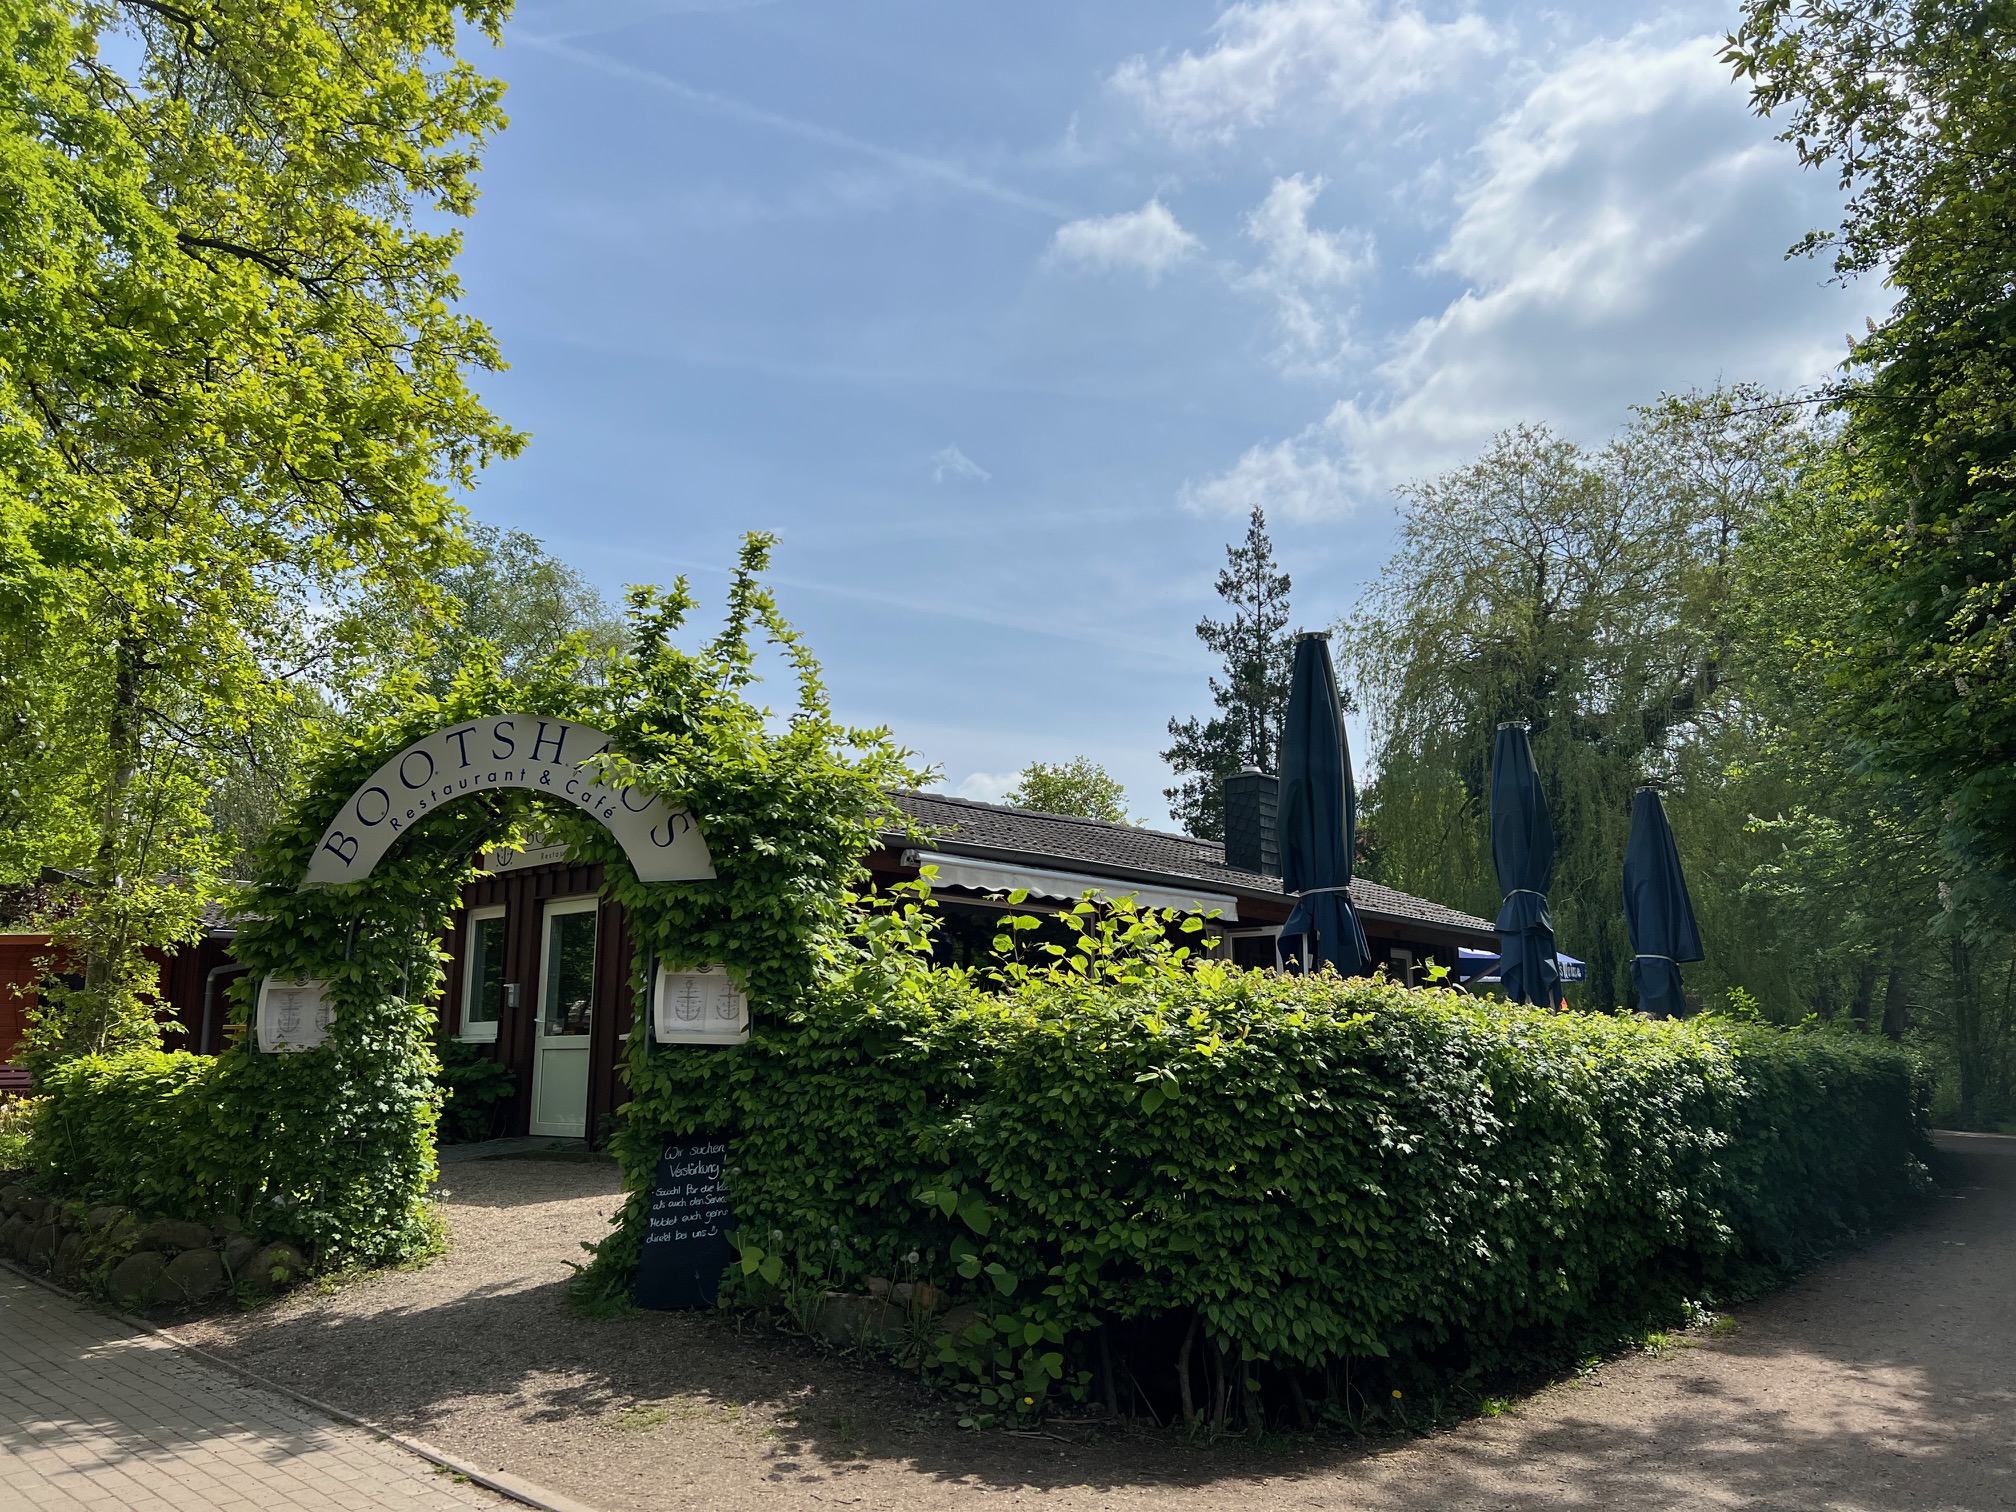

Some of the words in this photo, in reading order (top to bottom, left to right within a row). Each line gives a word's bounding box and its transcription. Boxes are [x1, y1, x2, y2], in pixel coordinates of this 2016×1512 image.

[390, 768, 527, 832] Restaurant
[539, 769, 552, 786] &
[565, 779, 616, 820] Café
[665, 1146, 684, 1160] Wir
[689, 1142, 725, 1155] suchen
[700, 1185, 714, 1193] die
[653, 1200, 666, 1210] als
[668, 1197, 686, 1208] auch
[689, 1197, 705, 1206] den
[650, 1216, 677, 1228] Meldet
[704, 1209, 728, 1224] gerne
[646, 1232, 671, 1244] direkt
[675, 1230, 687, 1241] bei
[692, 1229, 707, 1238] uns
